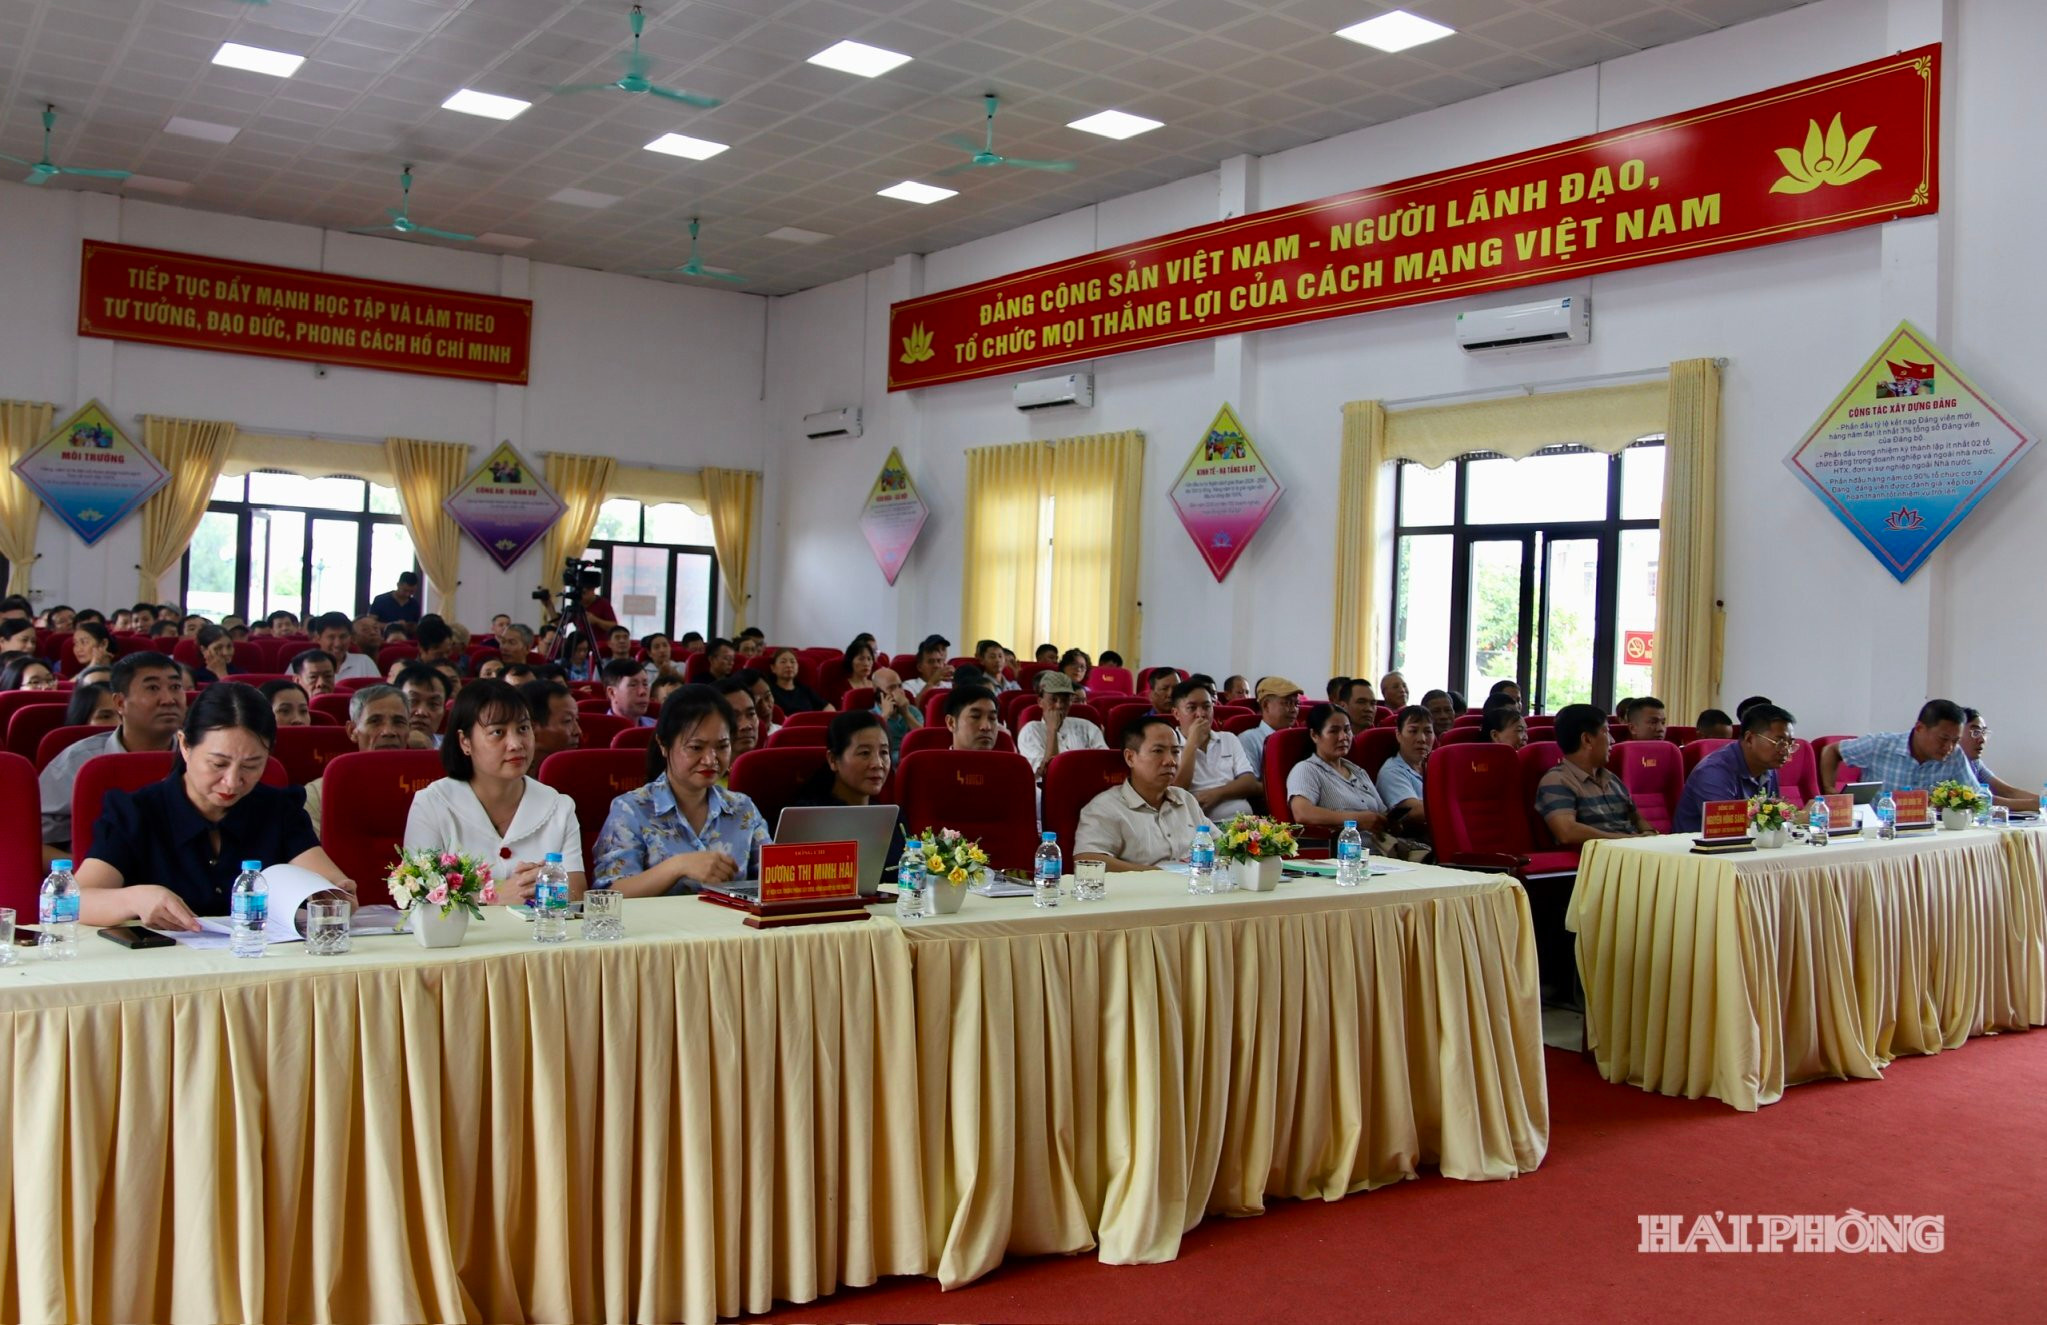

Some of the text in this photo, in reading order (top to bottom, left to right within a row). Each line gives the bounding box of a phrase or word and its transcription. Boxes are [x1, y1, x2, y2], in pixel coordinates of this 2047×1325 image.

[979, 292, 1035, 326] ĐẢNG
[1040, 278, 1101, 313] CỘNG
[1108, 260, 1159, 297] SẢN
[1166, 250, 1224, 284] VIỆT
[1231, 234, 1300, 271] NAM
[1330, 202, 1436, 252] NGƯỜI
[1446, 179, 1548, 228] LÃNH
[1559, 159, 1659, 204] ĐẠO,
[128, 265, 169, 291] TIẾP
[175, 274, 210, 300] TỤC
[256, 286, 310, 312] MẠNH
[314, 294, 349, 318] HỌC
[354, 297, 386, 322] TẬP
[390, 301, 412, 323] VÀ
[415, 305, 451, 328] LÀM
[455, 311, 495, 334] THEO
[955, 192, 1721, 364] TỔ CHỨC MỌI THẮNG LỢI CỦA CÁCH MẠNG VIỆT NAM
[104, 297, 131, 319] TƯ
[133, 296, 202, 332] TƯỞNG,
[206, 311, 244, 336] ĐẠO
[249, 313, 291, 342] ĐỨC,
[296, 322, 356, 347] PHONG
[360, 328, 406, 352] CÁCH
[436, 338, 465, 359] CHÍ
[468, 342, 512, 364] MINH
[1849, 397, 1957, 418] CÔNG TÁC XÂY DỰNG ĐẢNG
[62, 451, 125, 464] MÔI TRƯỜNG
[765, 855, 853, 886] DƯƠNG THỊ MINH HẢI
